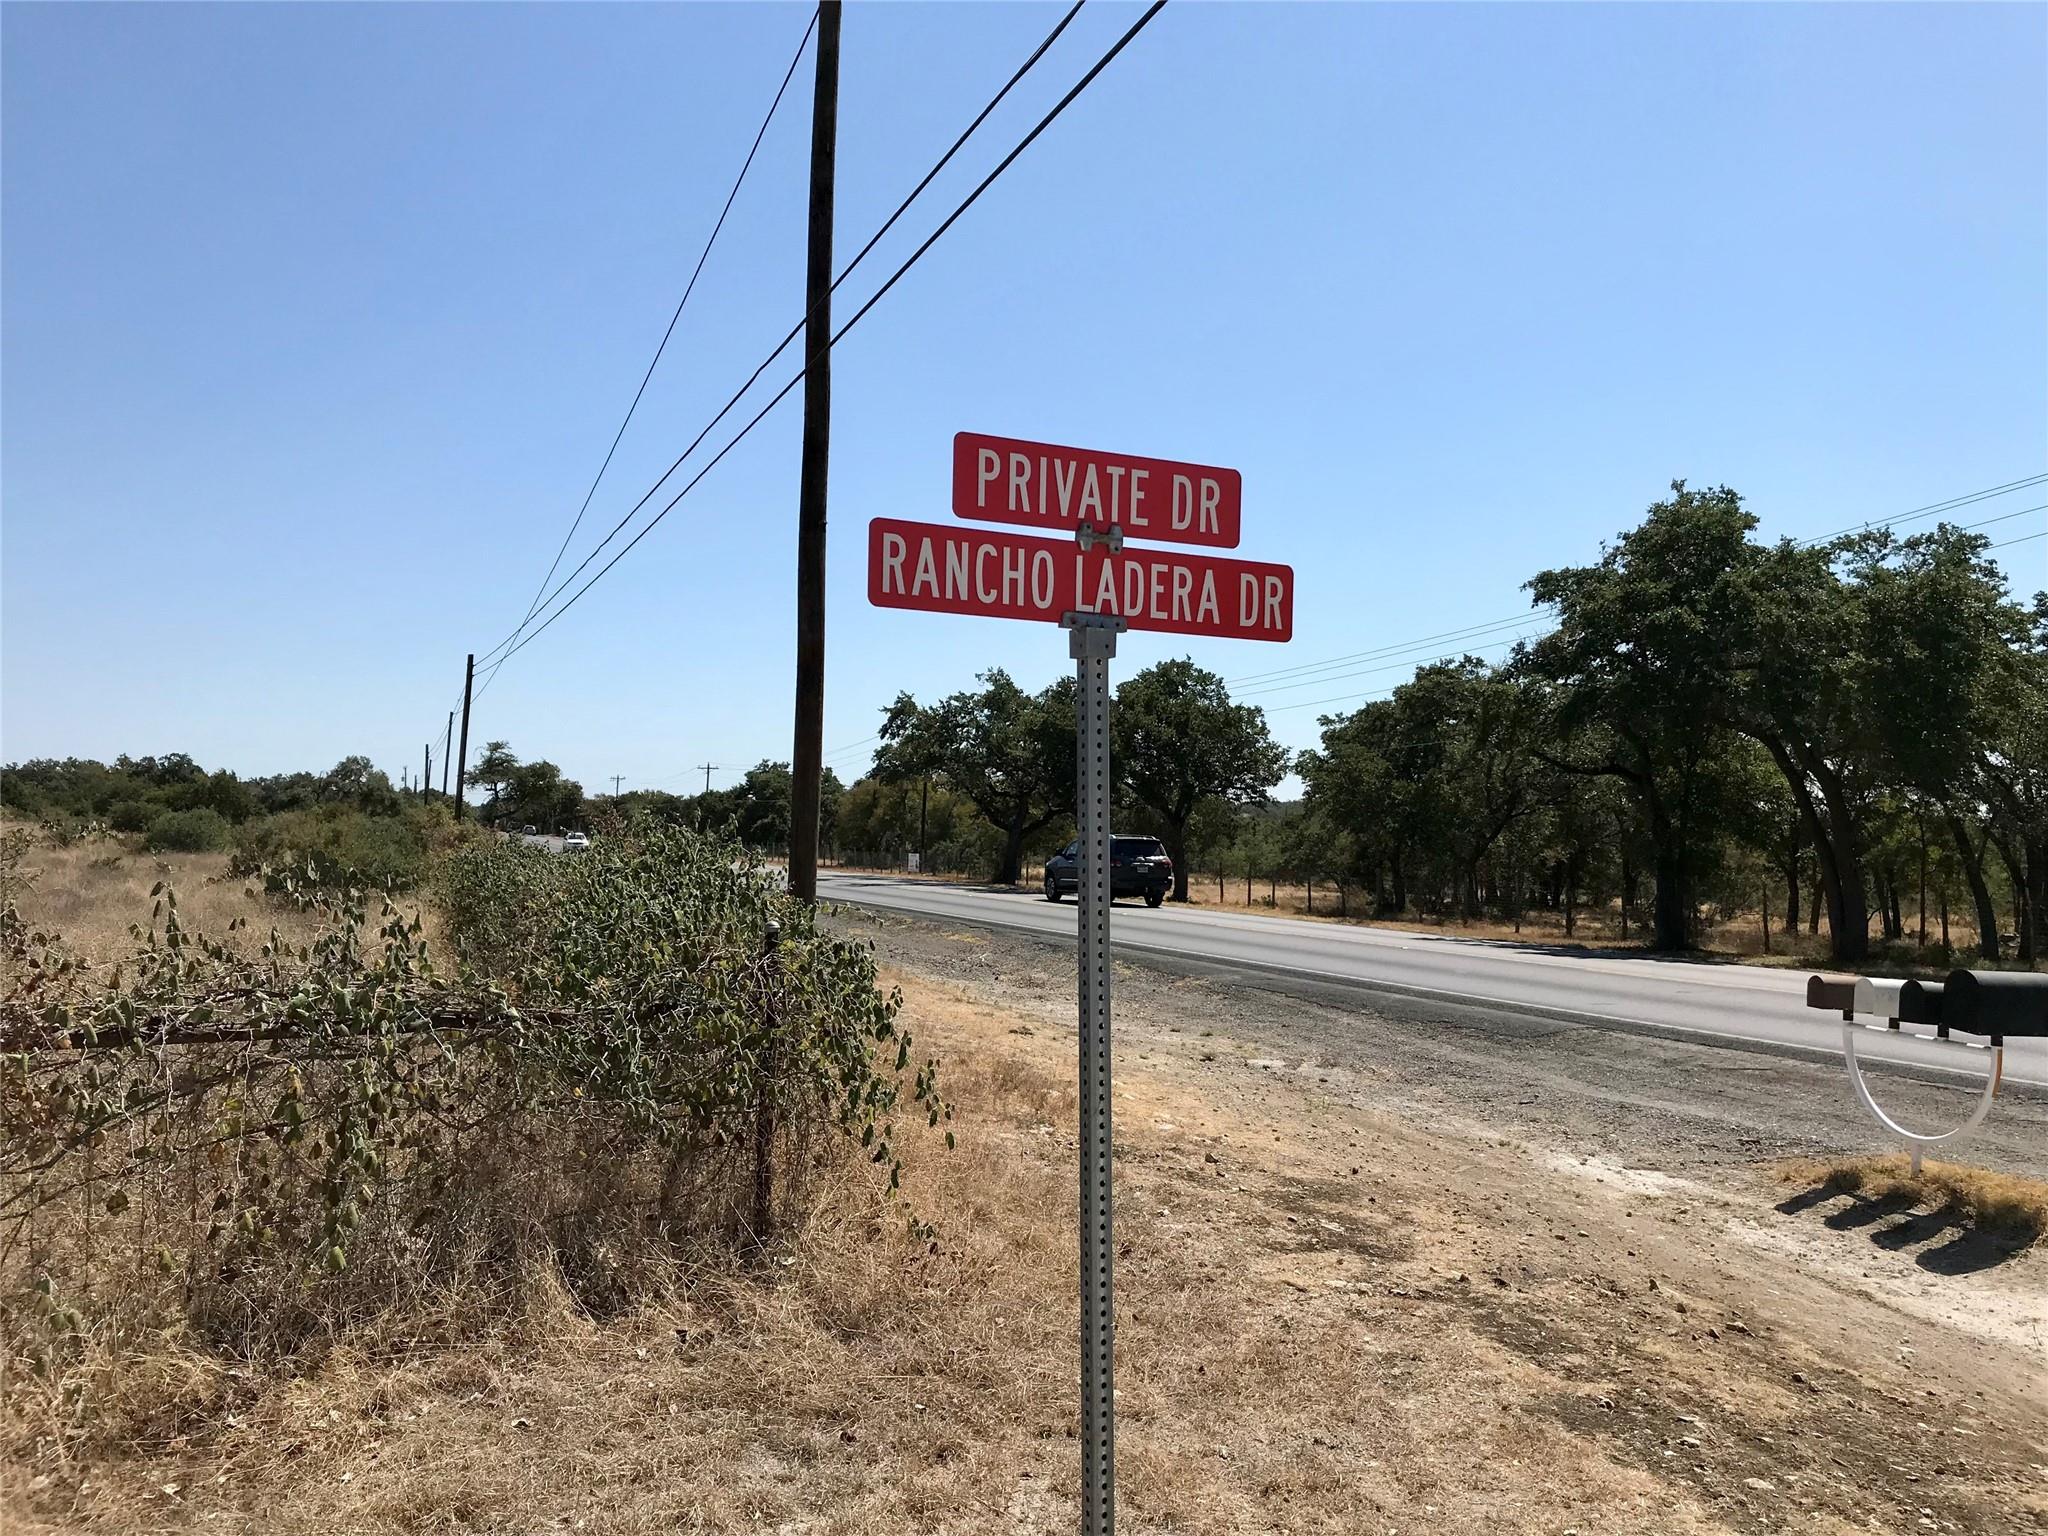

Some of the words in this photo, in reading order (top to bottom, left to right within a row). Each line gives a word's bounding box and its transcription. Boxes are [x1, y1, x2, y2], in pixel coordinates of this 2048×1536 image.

[977, 448, 1150, 527] PRIVATE
[1171, 474, 1221, 535] DR
[882, 532, 1055, 609] RANCHO
[1075, 554, 1221, 625] LADERA
[1239, 573, 1285, 630] DR
